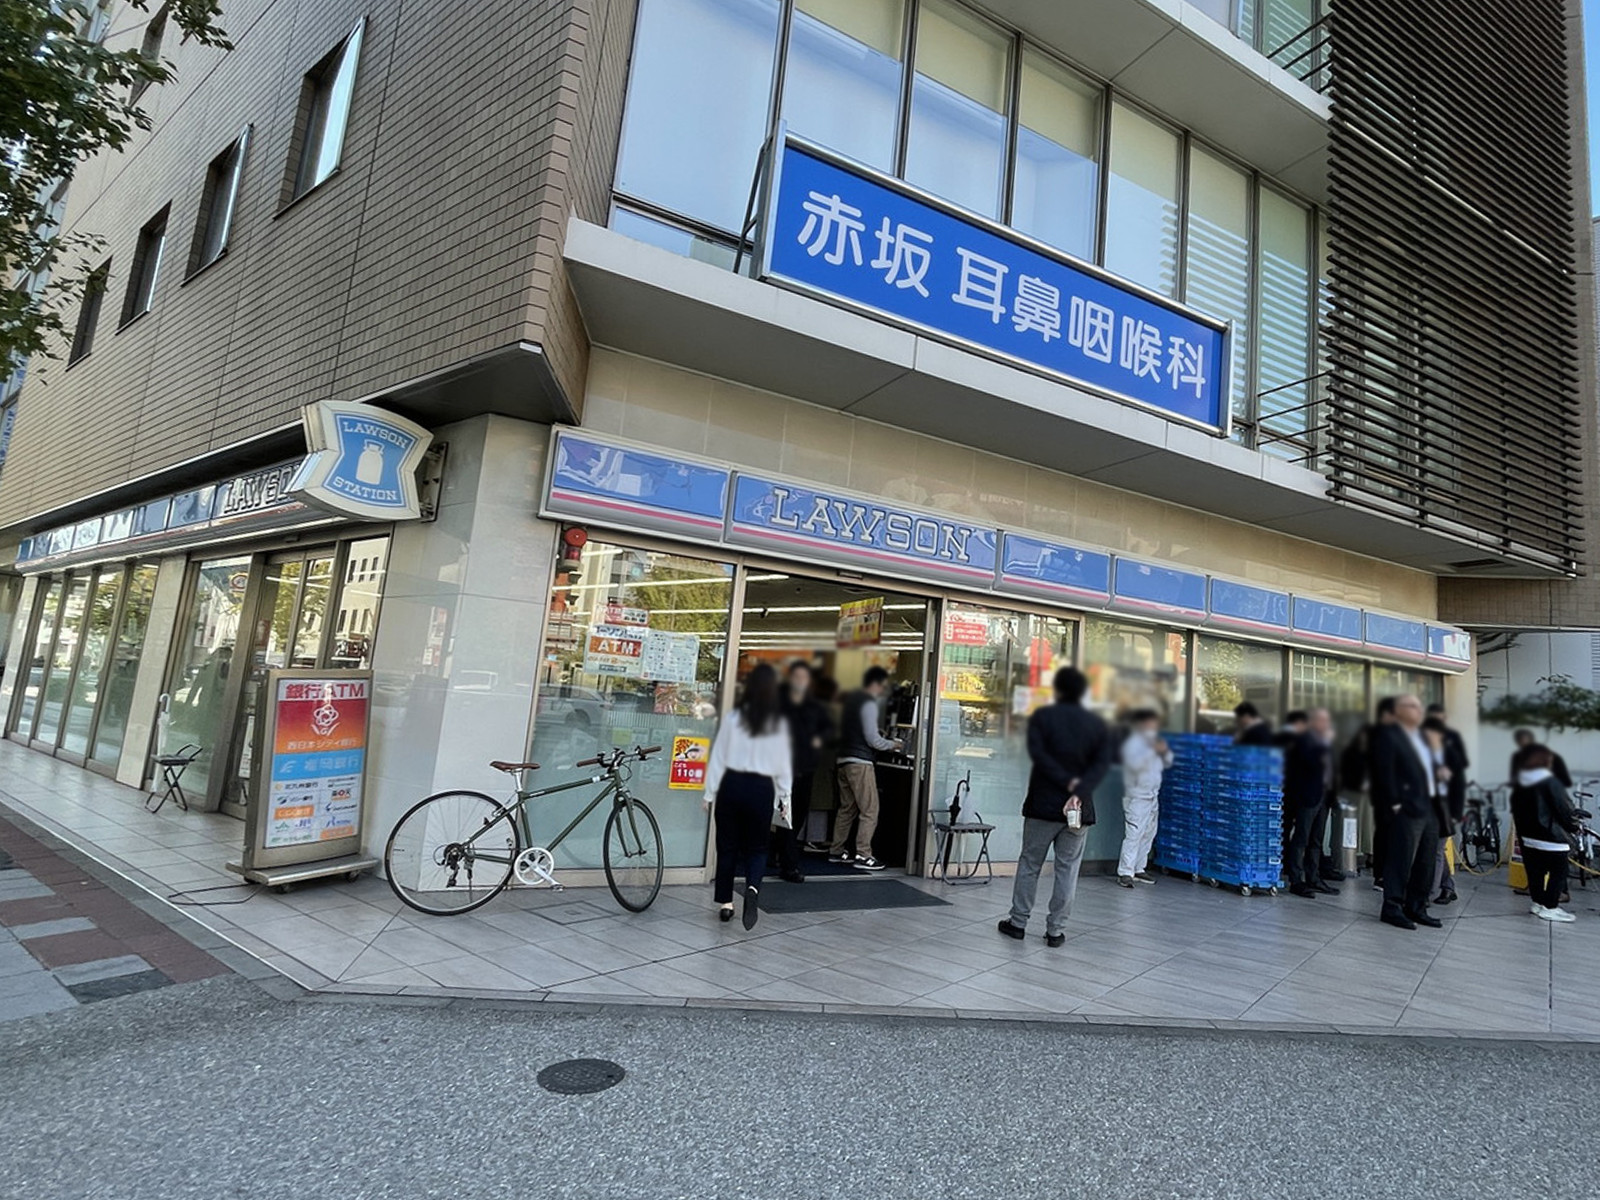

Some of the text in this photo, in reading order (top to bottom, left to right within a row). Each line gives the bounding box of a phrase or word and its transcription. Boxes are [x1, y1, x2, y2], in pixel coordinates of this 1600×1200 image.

[797, 190, 1206, 399] 赤坂 耳鼻咽喉科
[343, 422, 408, 449] LAWSON
[223, 464, 300, 514] LAWSO
[332, 476, 397, 500] STATION
[769, 486, 972, 563] LAWSON
[598, 641, 635, 655] ATM
